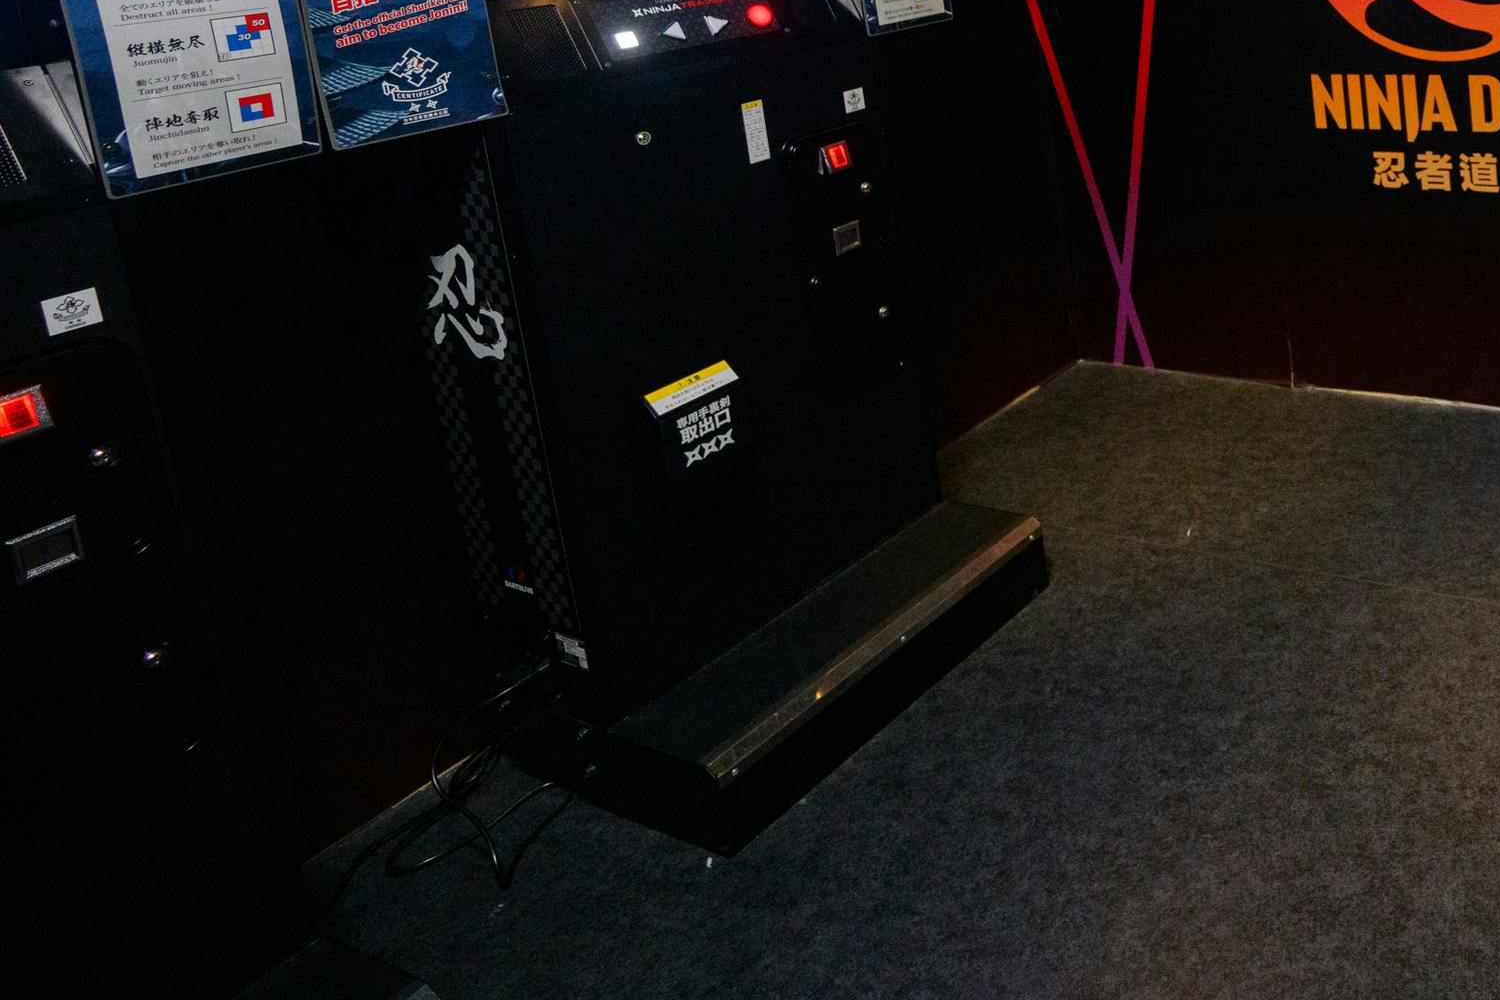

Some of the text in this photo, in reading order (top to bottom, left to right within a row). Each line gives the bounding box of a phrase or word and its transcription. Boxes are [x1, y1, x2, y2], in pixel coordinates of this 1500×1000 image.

[120, 11, 163, 22] Destruct
[181, 6, 207, 15] areas
[334, 24, 353, 35] Get
[353, 20, 371, 29] the
[372, 8, 405, 24] official
[336, 0, 469, 48] aim to become Jonin!!
[237, 33, 251, 41] 30
[137, 86, 169, 96] Target
[172, 80, 208, 90] moving
[210, 76, 235, 84] areas
[396, 85, 443, 99] CERTIFICATE
[1310, 73, 1458, 143] NINJA
[153, 158, 185, 169] Capture
[201, 151, 221, 159] other
[254, 140, 273, 148] areas
[425, 244, 507, 360] 忍
[680, 407, 732, 445] 取出口
